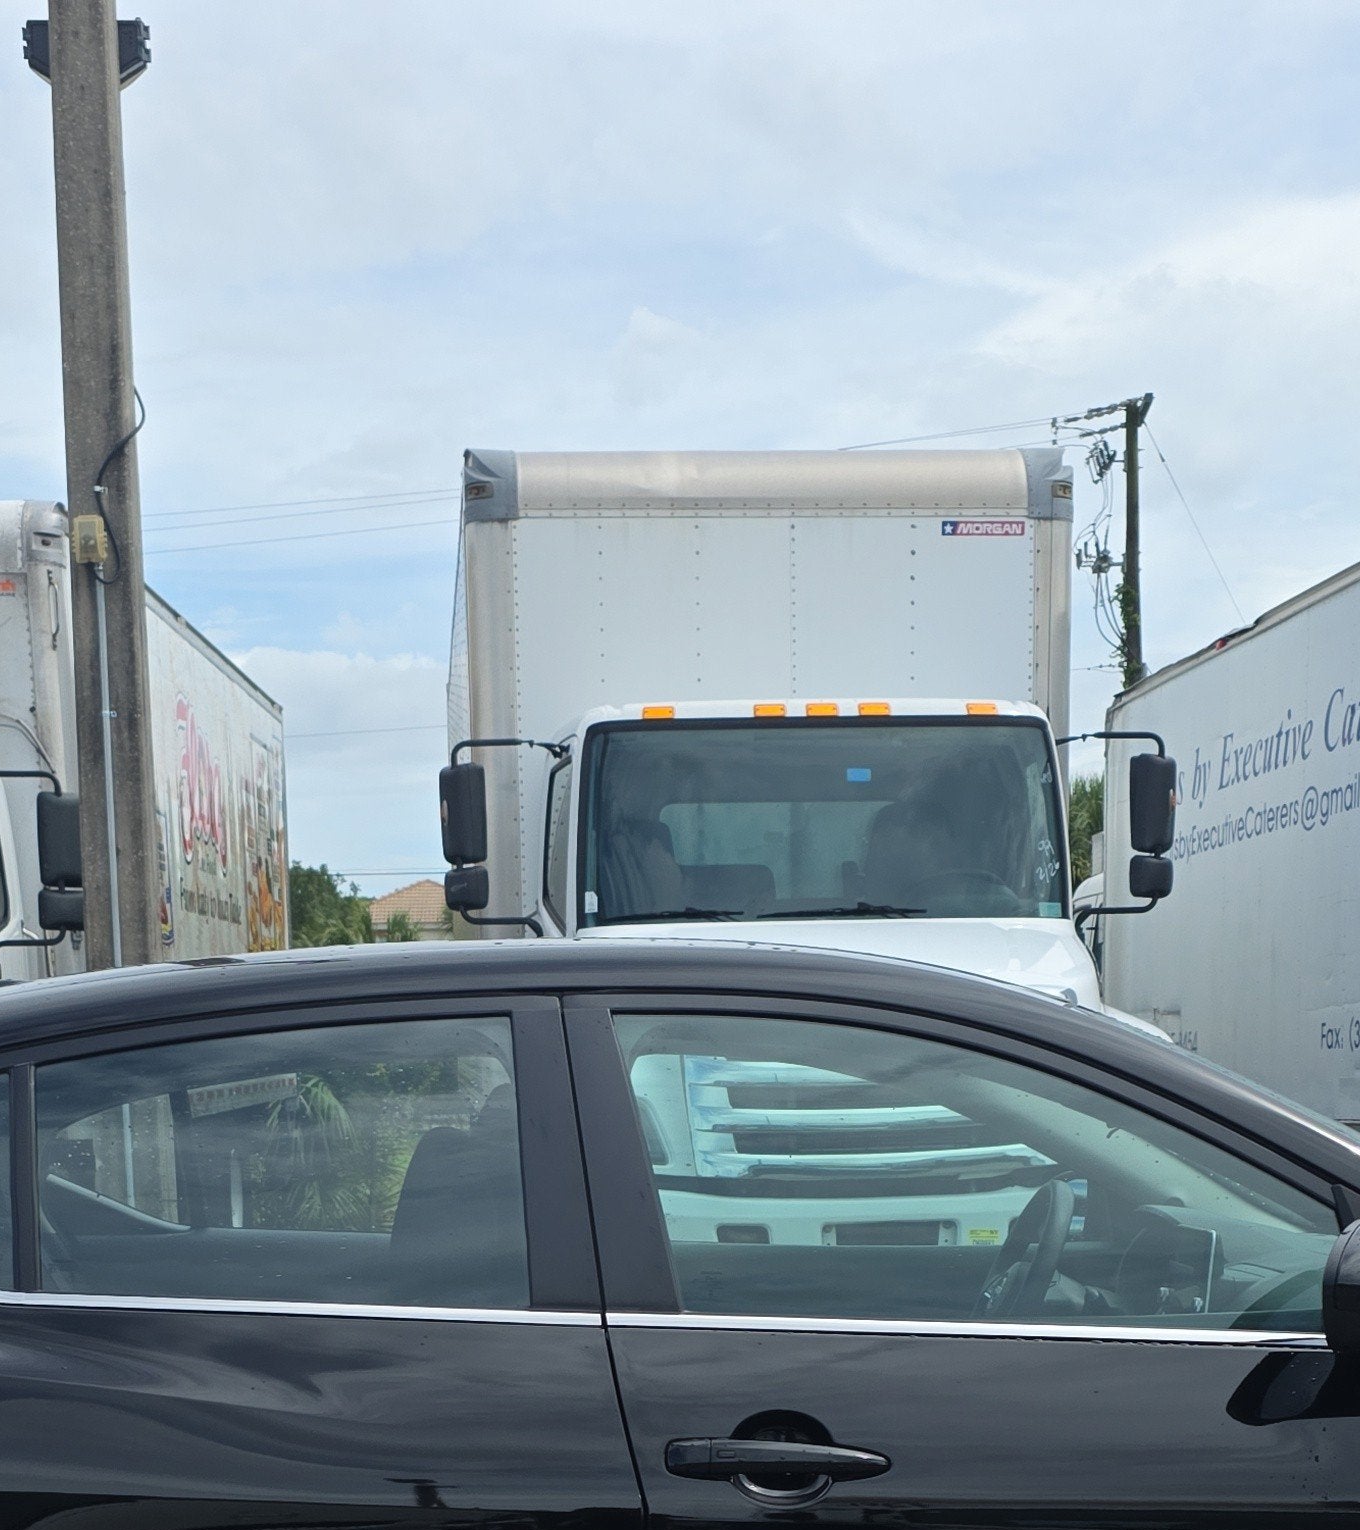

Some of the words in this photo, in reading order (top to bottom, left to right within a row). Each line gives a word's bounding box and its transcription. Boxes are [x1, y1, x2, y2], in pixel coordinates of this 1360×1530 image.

[956, 522, 1023, 535] MORGAN
[1191, 747, 1211, 810] by
[1217, 708, 1314, 792] Executive
[1321, 1021, 1344, 1050] Fax:
